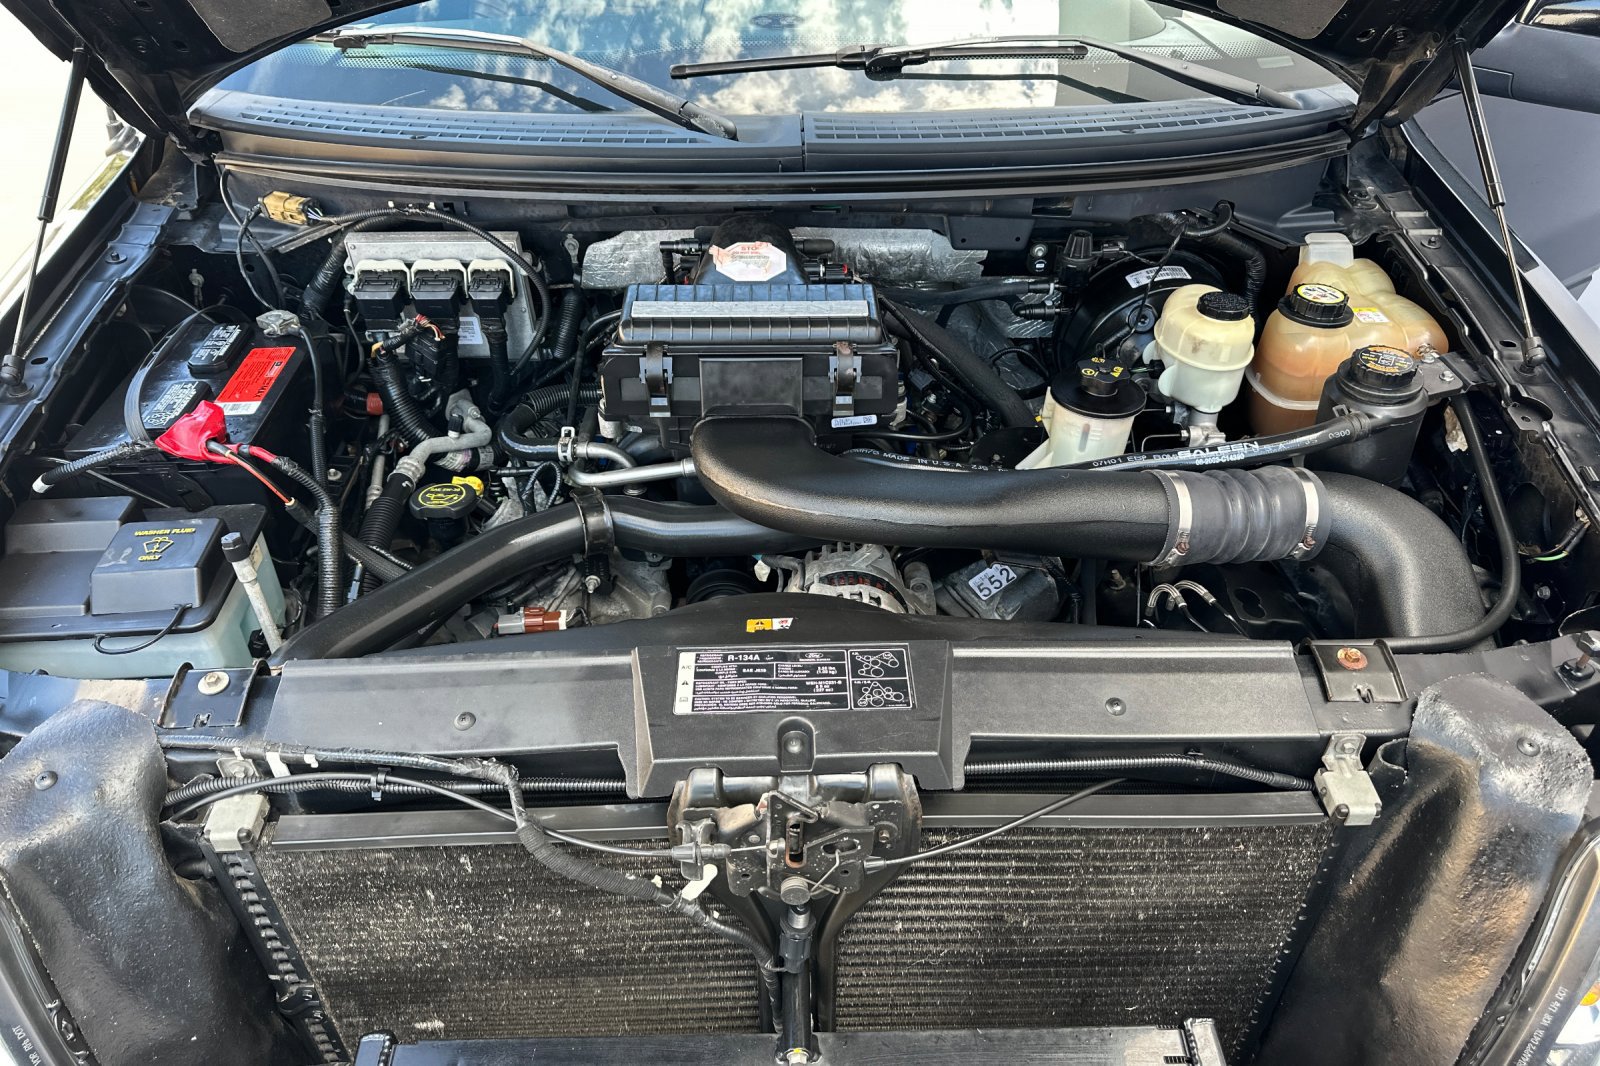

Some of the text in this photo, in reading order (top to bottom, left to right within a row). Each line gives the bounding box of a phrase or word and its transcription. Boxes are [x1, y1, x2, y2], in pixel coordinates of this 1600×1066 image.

[1177, 441, 1259, 459] SALEEN
[882, 452, 910, 462] MADE
[932, 460, 965, 468] U.S.A.
[976, 568, 1016, 597] 552
[1555, 986, 1569, 1000] DOT
[12, 1024, 26, 1040] DOT
